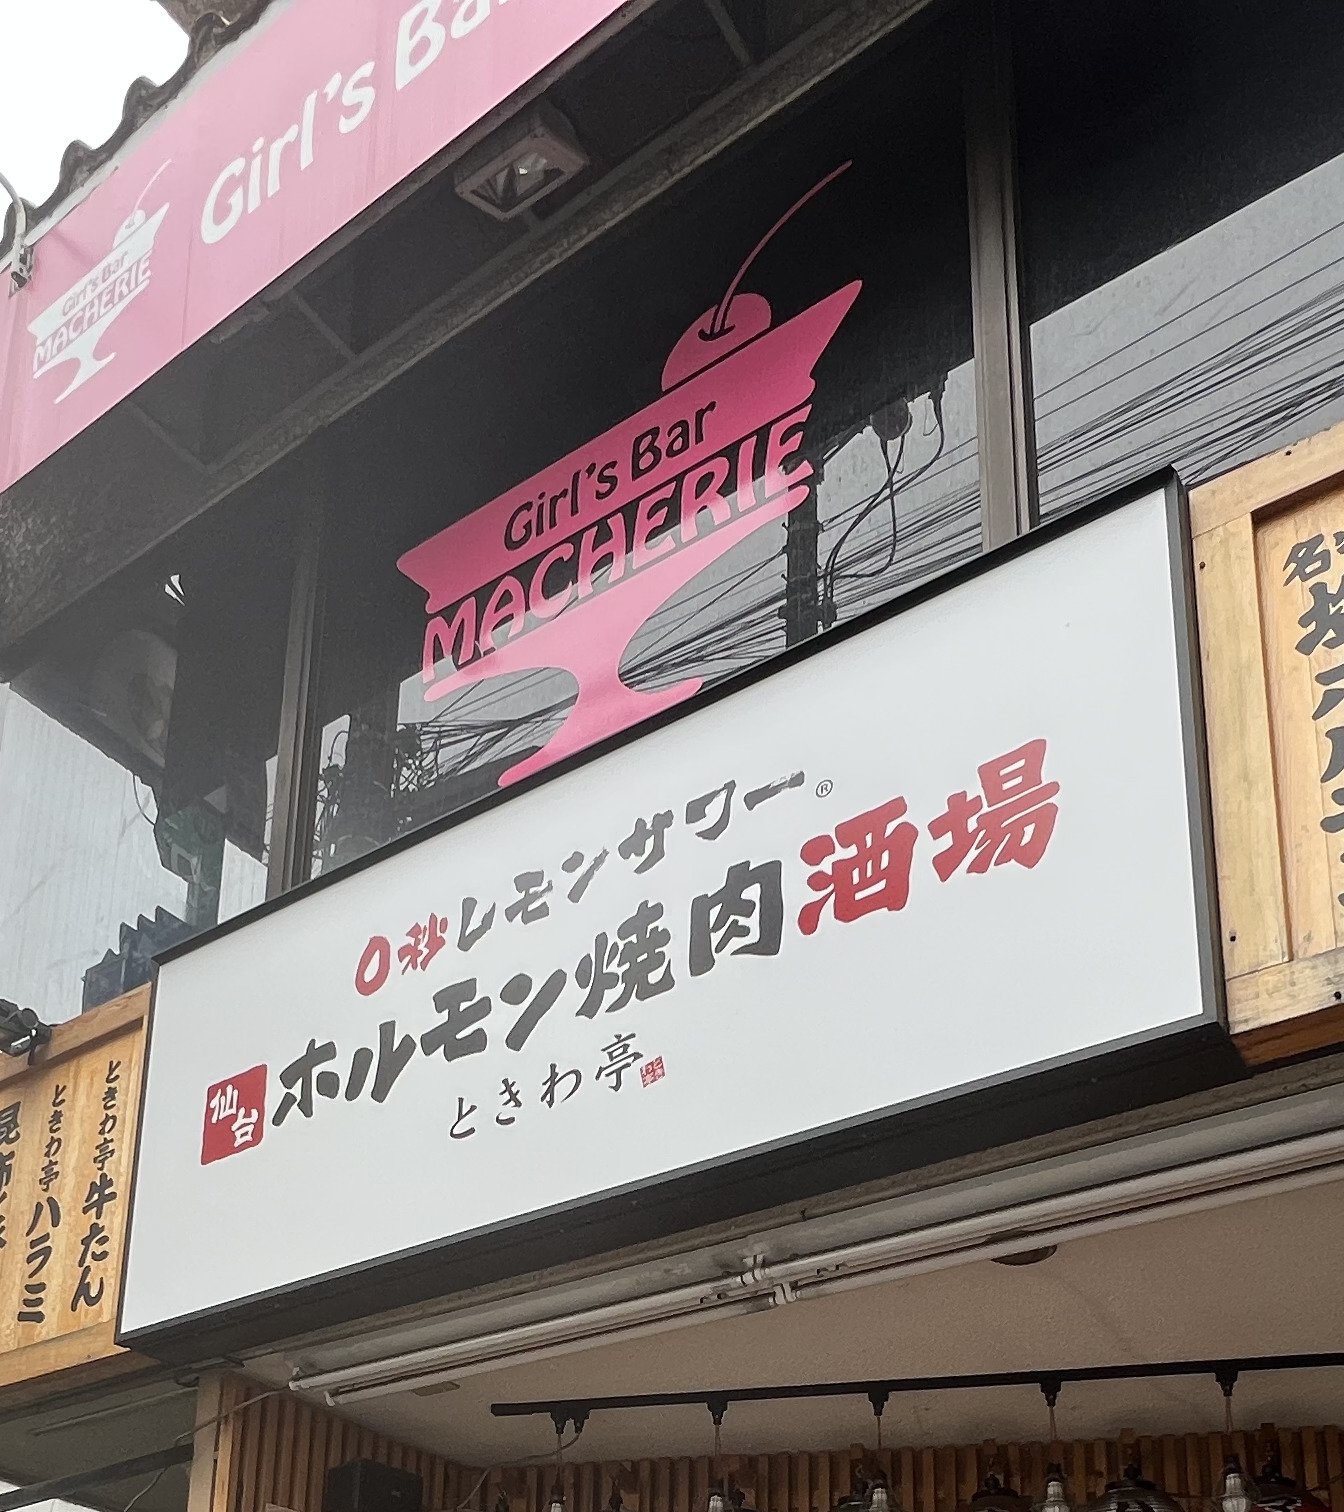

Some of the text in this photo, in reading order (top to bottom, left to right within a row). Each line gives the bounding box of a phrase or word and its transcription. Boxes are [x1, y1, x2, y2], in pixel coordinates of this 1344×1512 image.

[199, 0, 506, 247] Girl's Ba
[33, 253, 154, 373] MACHERIE
[423, 403, 815, 684] MACHERIE
[504, 399, 717, 551] Girl's Bar
[270, 737, 1062, 1130] ホルモン焼肉酒場
[449, 1032, 644, 1140] ときわ亭
